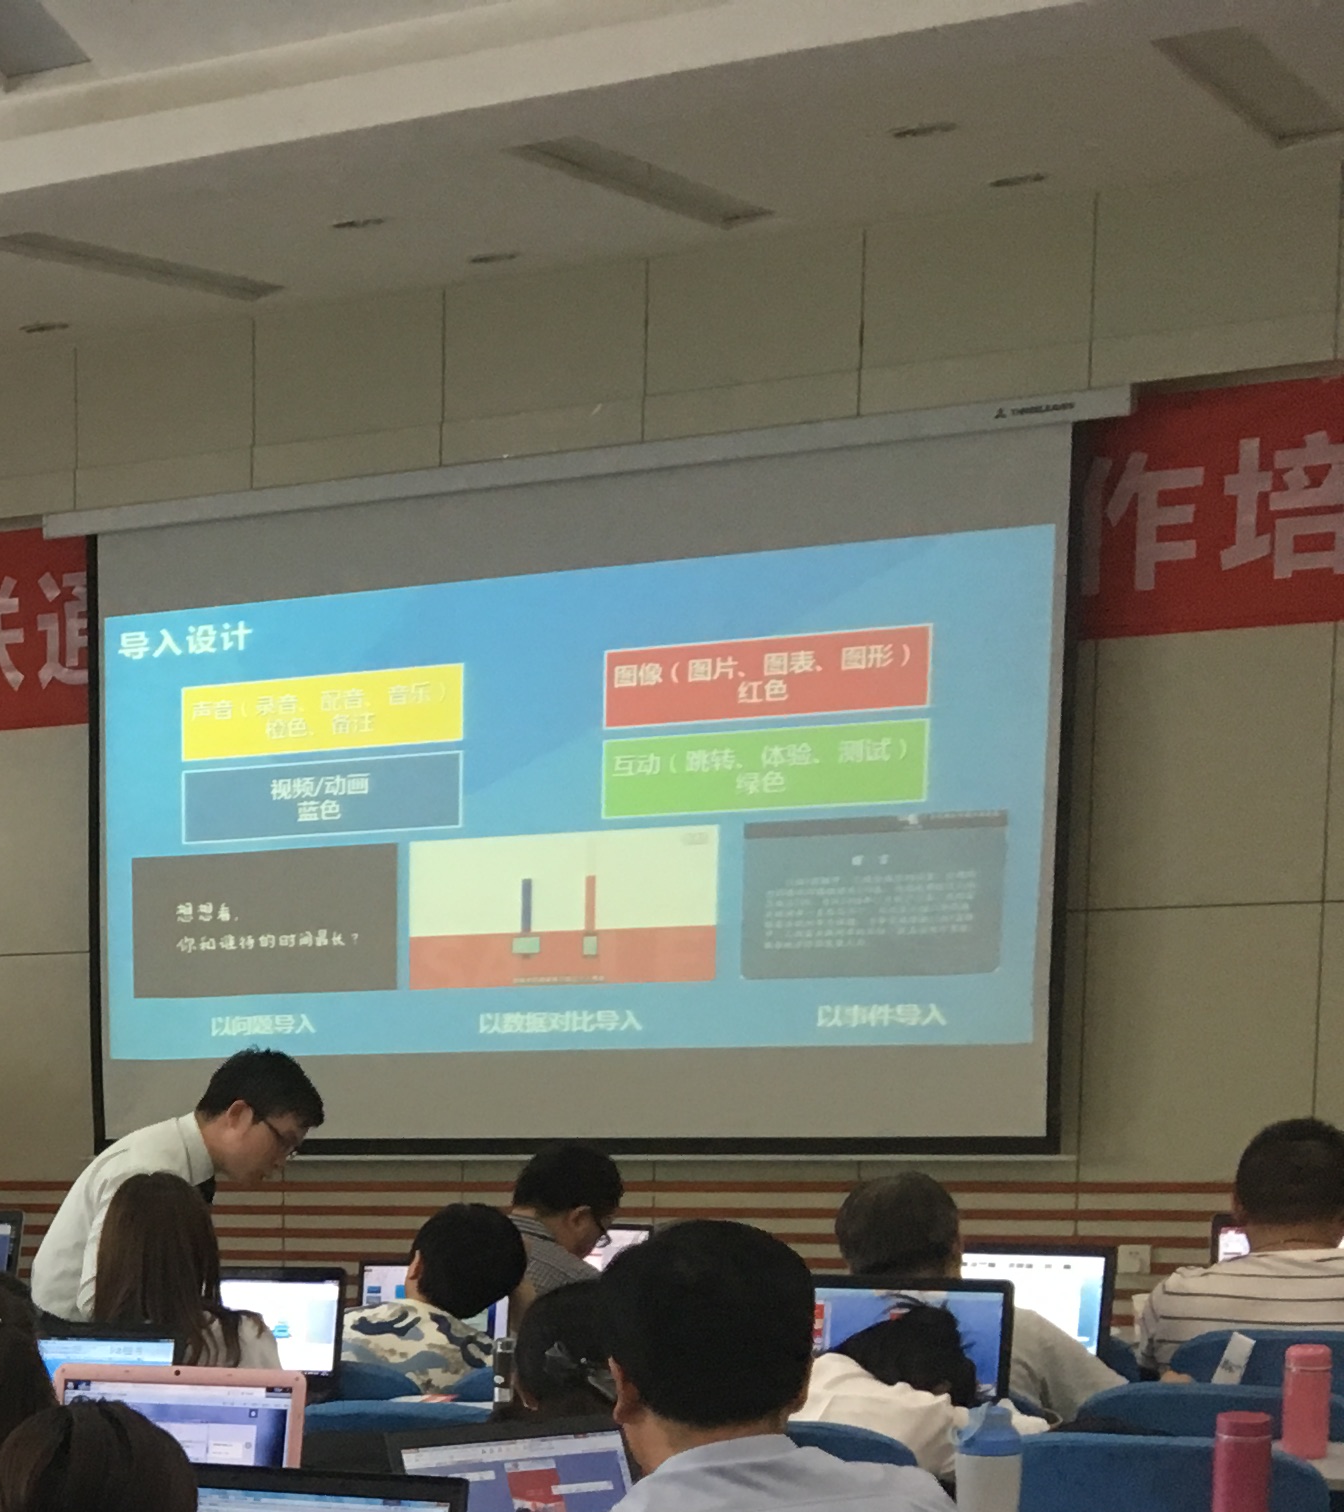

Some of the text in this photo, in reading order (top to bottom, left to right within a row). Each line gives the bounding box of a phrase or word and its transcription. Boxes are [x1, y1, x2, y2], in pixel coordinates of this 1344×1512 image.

[118, 621, 252, 660] 导入设计
[737, 680, 789, 704] 红色
[270, 772, 370, 800] 视频/动画
[736, 771, 786, 794] 绿色
[297, 800, 341, 822] 蓝色
[211, 1014, 316, 1036] 以问题导入
[479, 1010, 642, 1034] 以数据对比导入
[816, 1004, 947, 1027] 以事件导入
